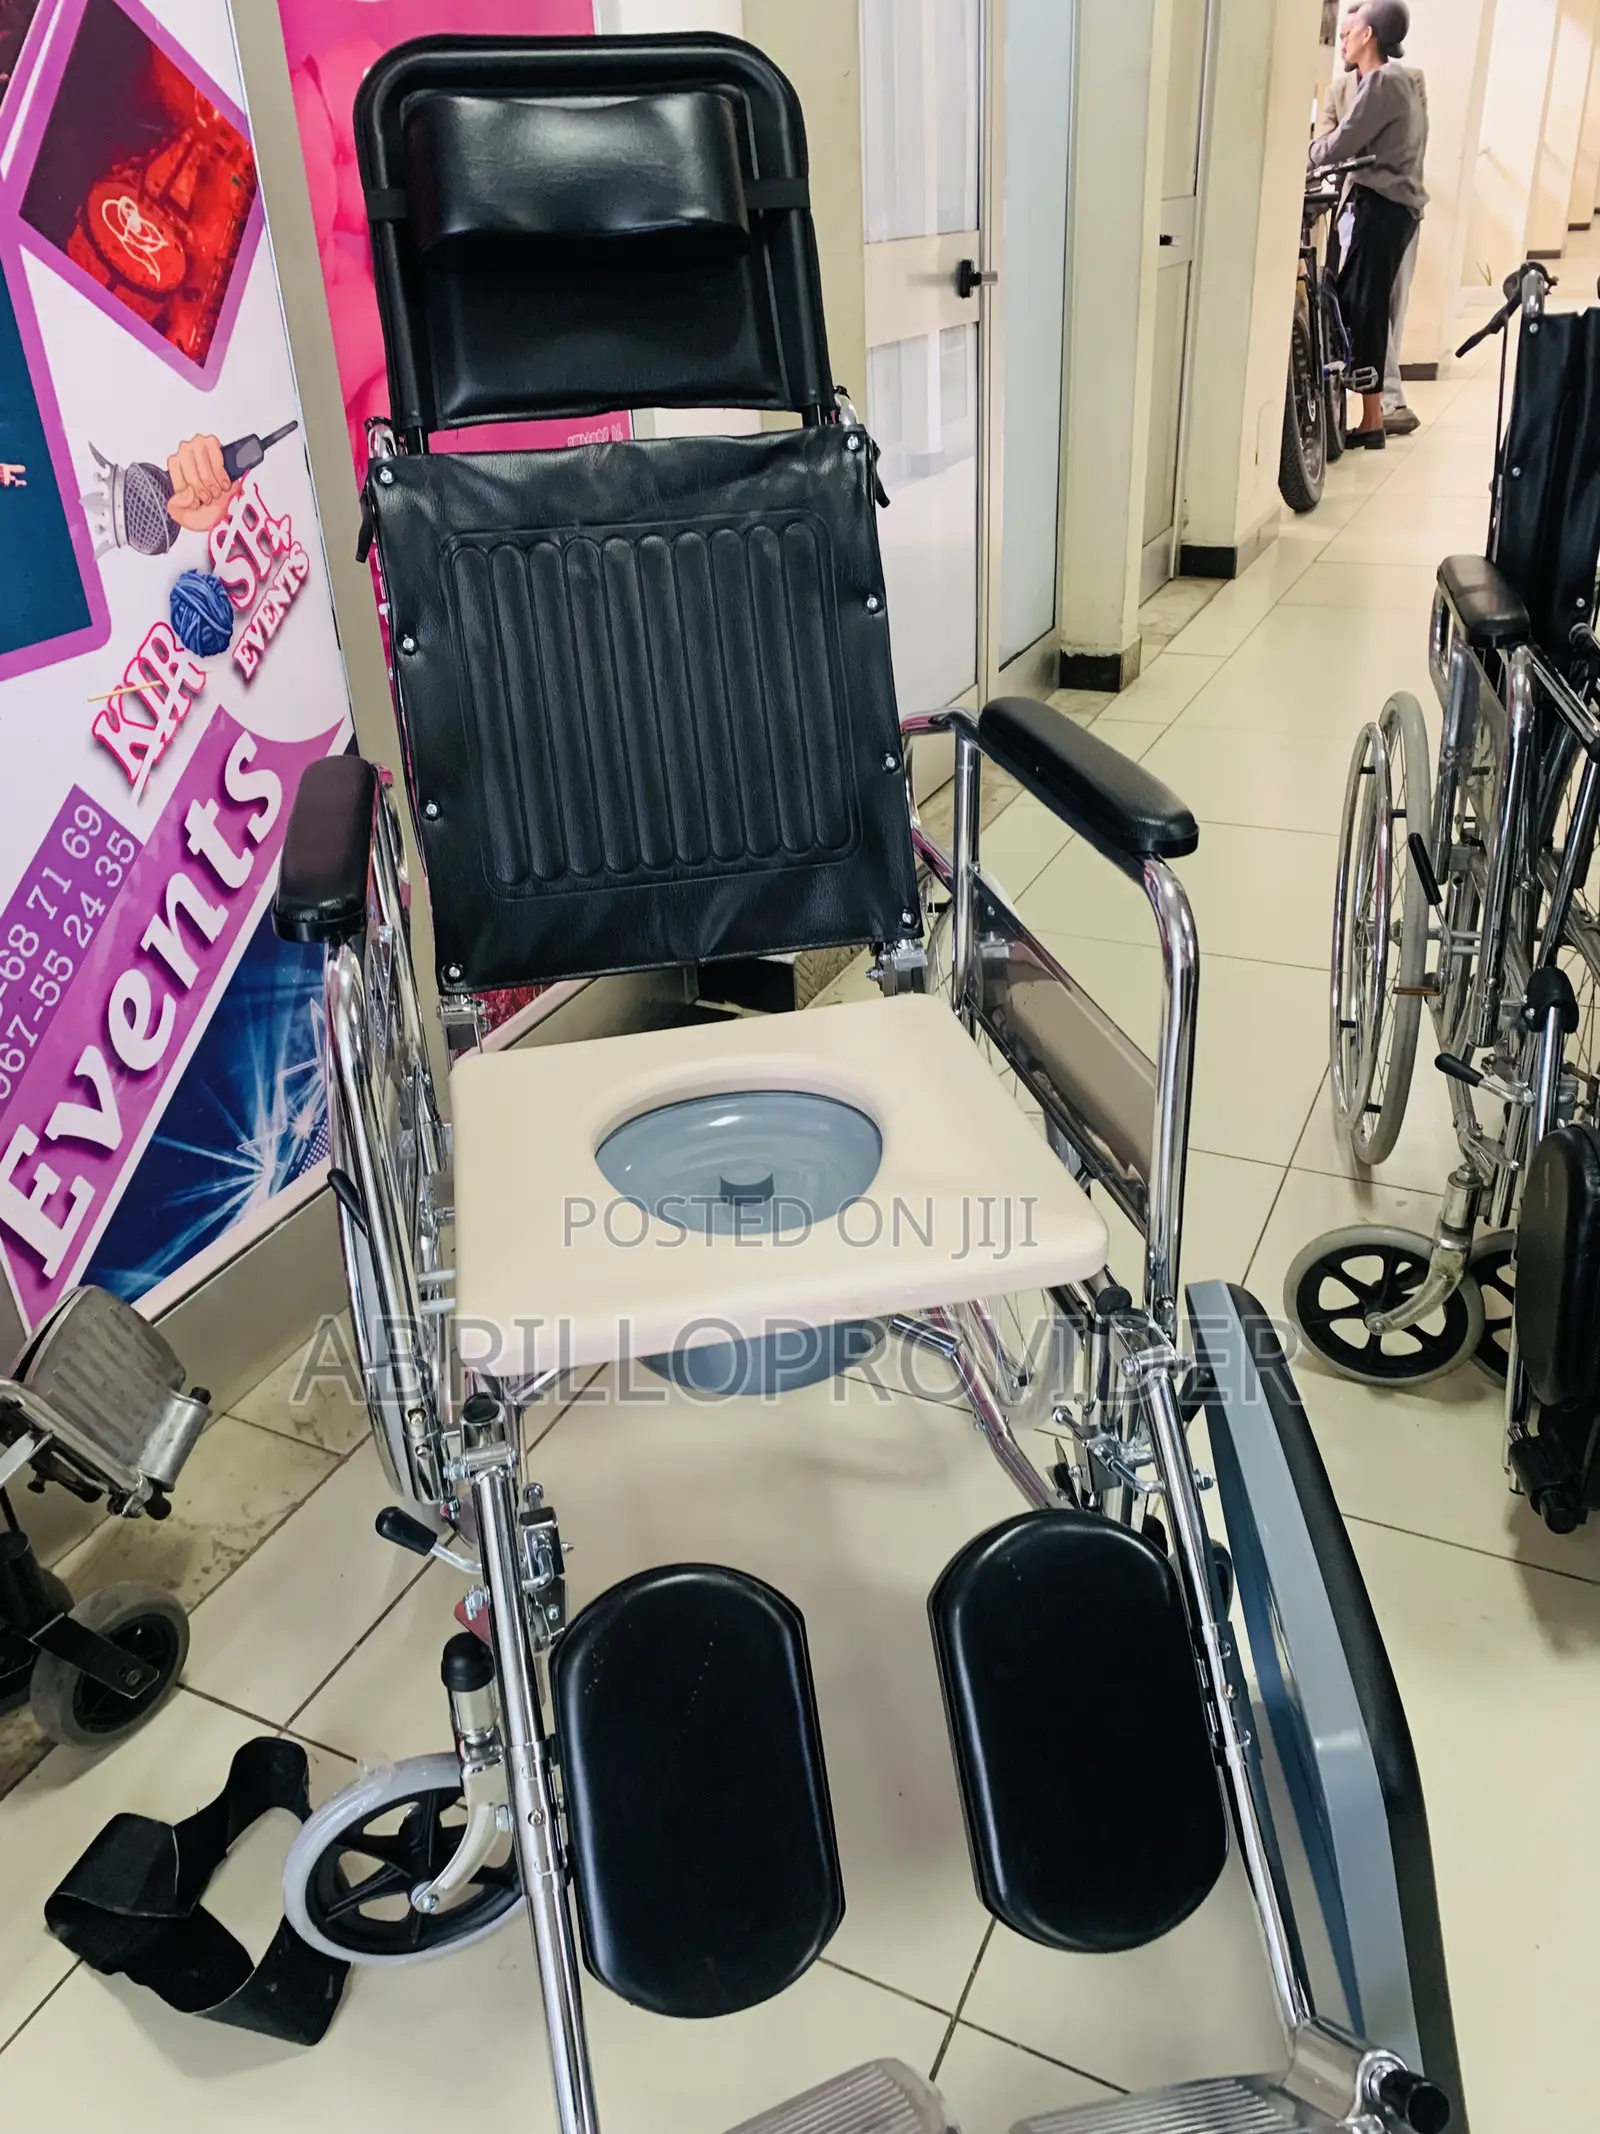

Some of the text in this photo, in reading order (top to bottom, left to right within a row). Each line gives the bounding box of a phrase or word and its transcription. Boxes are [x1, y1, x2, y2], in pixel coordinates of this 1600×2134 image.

[231, 541, 310, 680] EVENTS
[0, 804, 103, 1017] -68 71 69
[63, 890, 106, 949] 24
[95, 829, 135, 888] 35
[0, 730, 282, 1281] Events
